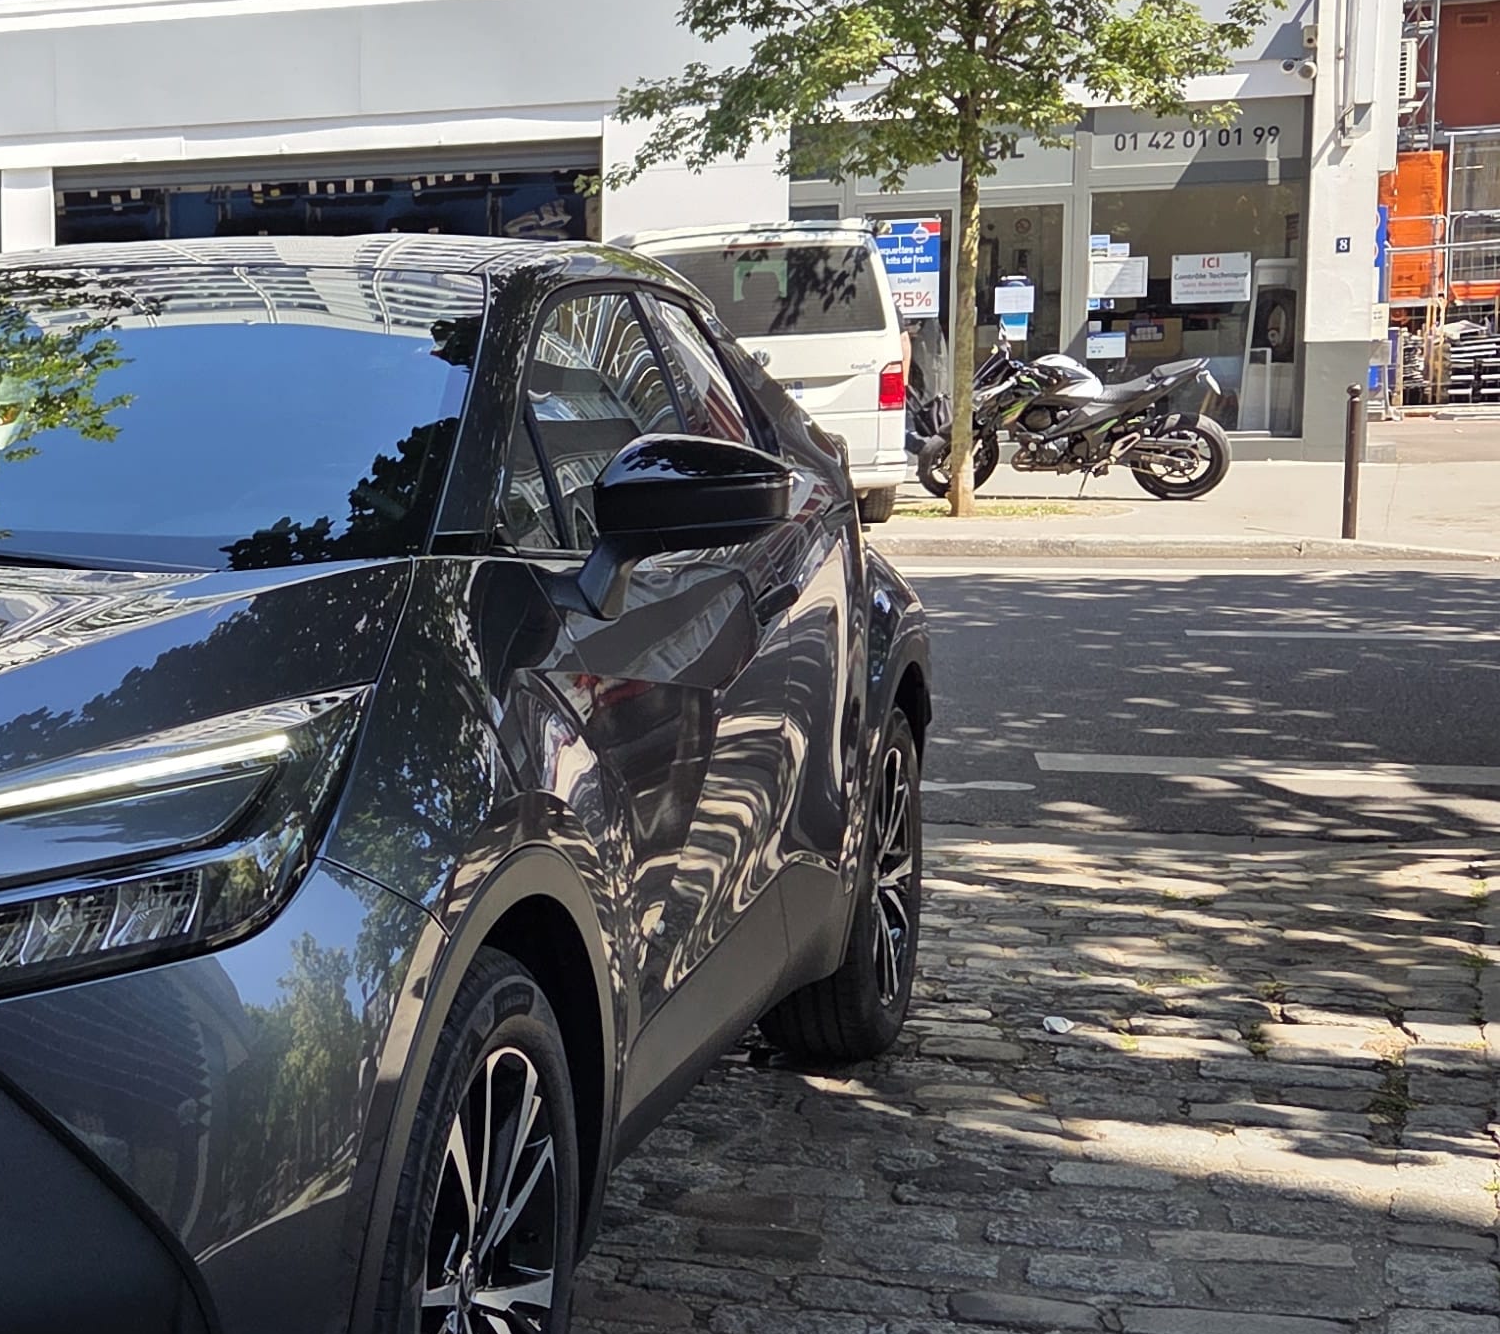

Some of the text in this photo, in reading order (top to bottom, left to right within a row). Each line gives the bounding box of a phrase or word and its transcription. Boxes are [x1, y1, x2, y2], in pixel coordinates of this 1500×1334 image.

[1113, 125, 1280, 151] 01 42 01 01 99
[880, 245, 924, 256] aquettes et
[1338, 238, 1349, 251] 8
[902, 255, 912, 264] de
[1202, 257, 1220, 269] ICI
